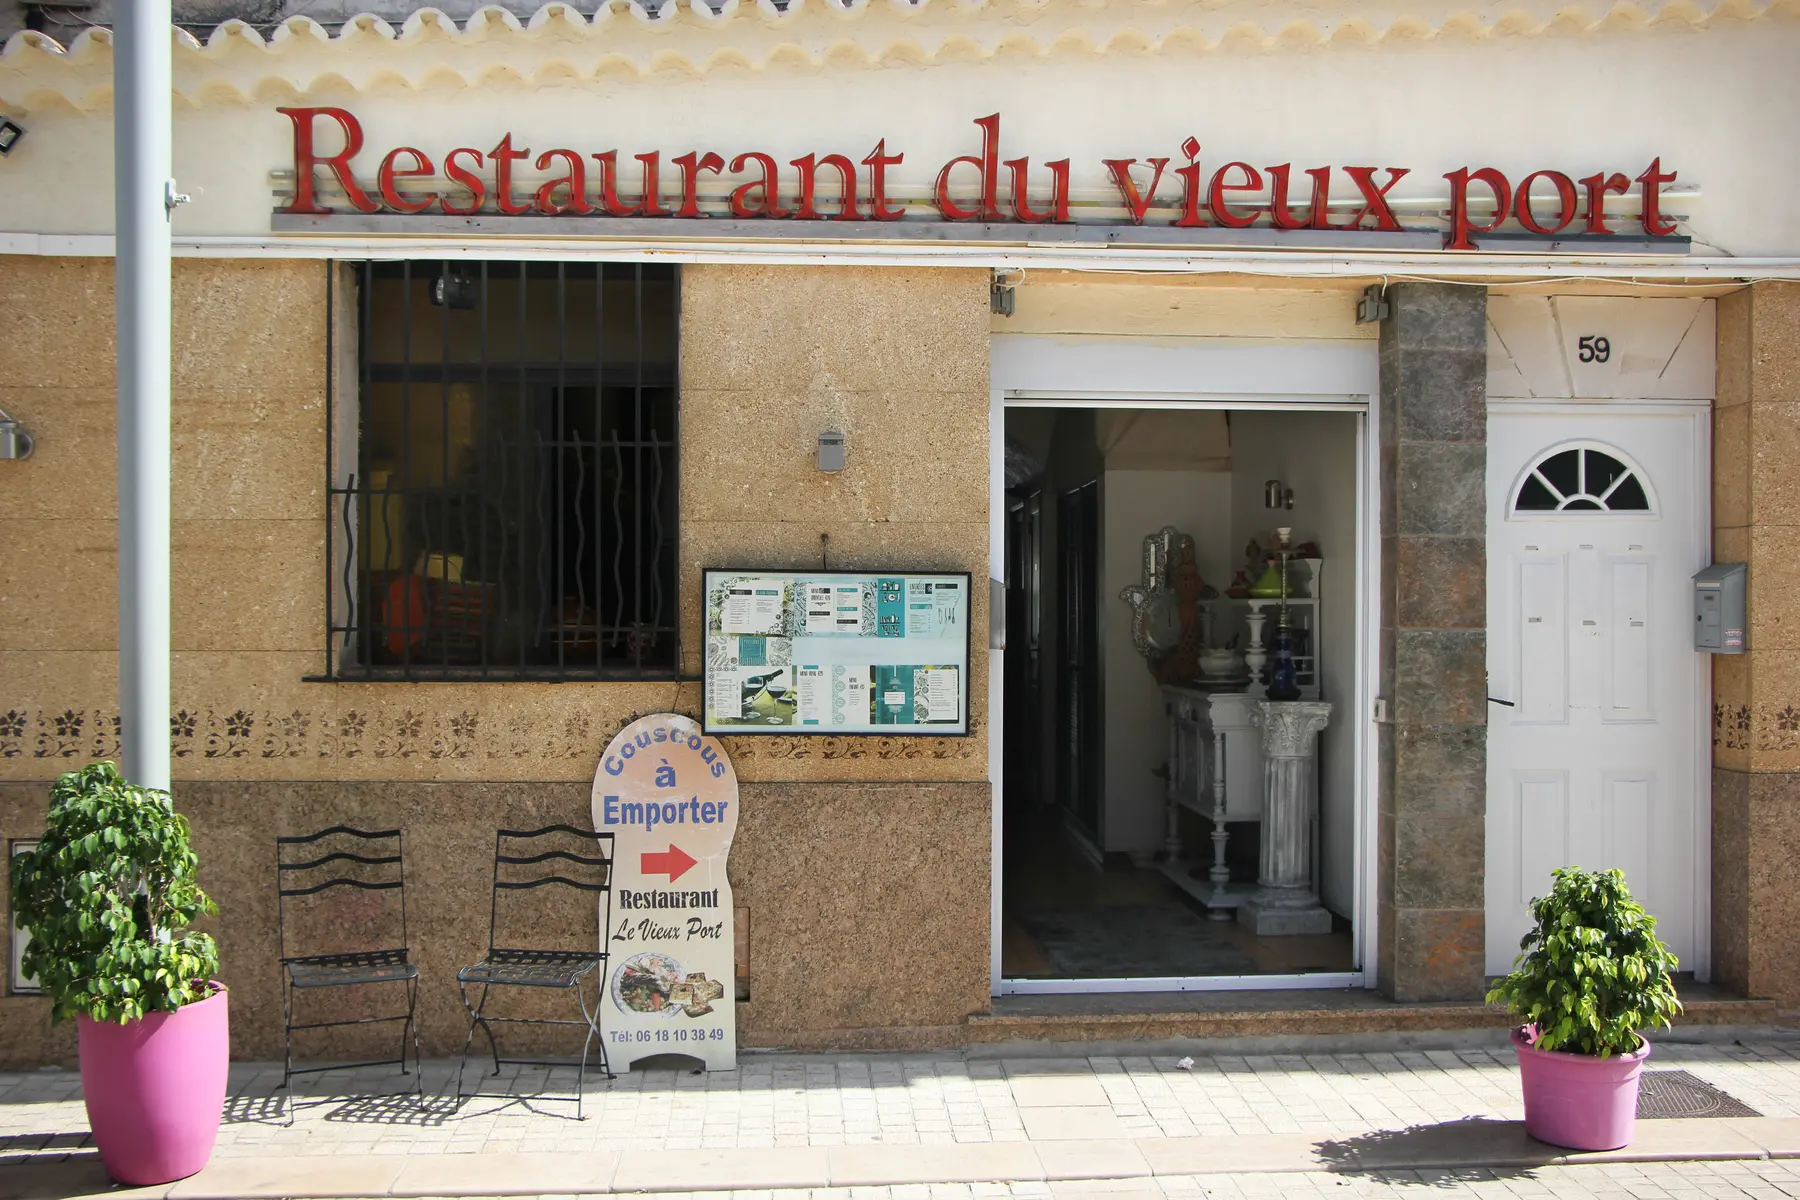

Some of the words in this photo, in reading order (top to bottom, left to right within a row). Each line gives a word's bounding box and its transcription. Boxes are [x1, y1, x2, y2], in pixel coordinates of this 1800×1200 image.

[276, 105, 905, 220] Restaurant
[933, 112, 1071, 224] du
[1101, 136, 1411, 232] vieux
[1441, 156, 1678, 250] port
[1578, 335, 1610, 363] 59
[604, 727, 726, 778] Couscous
[655, 758, 676, 787] à
[603, 795, 728, 832] Emporter
[619, 888, 719, 909] Restaurant
[612, 918, 635, 941] Le
[638, 918, 681, 941] Vieux
[686, 917, 723, 941] Port
[610, 1030, 632, 1042] Tél:
[636, 1030, 651, 1042] 06
[655, 1030, 669, 1042] 18
[673, 1030, 687, 1042] 10
[691, 1029, 706, 1041] 38
[709, 1028, 724, 1041] 49
